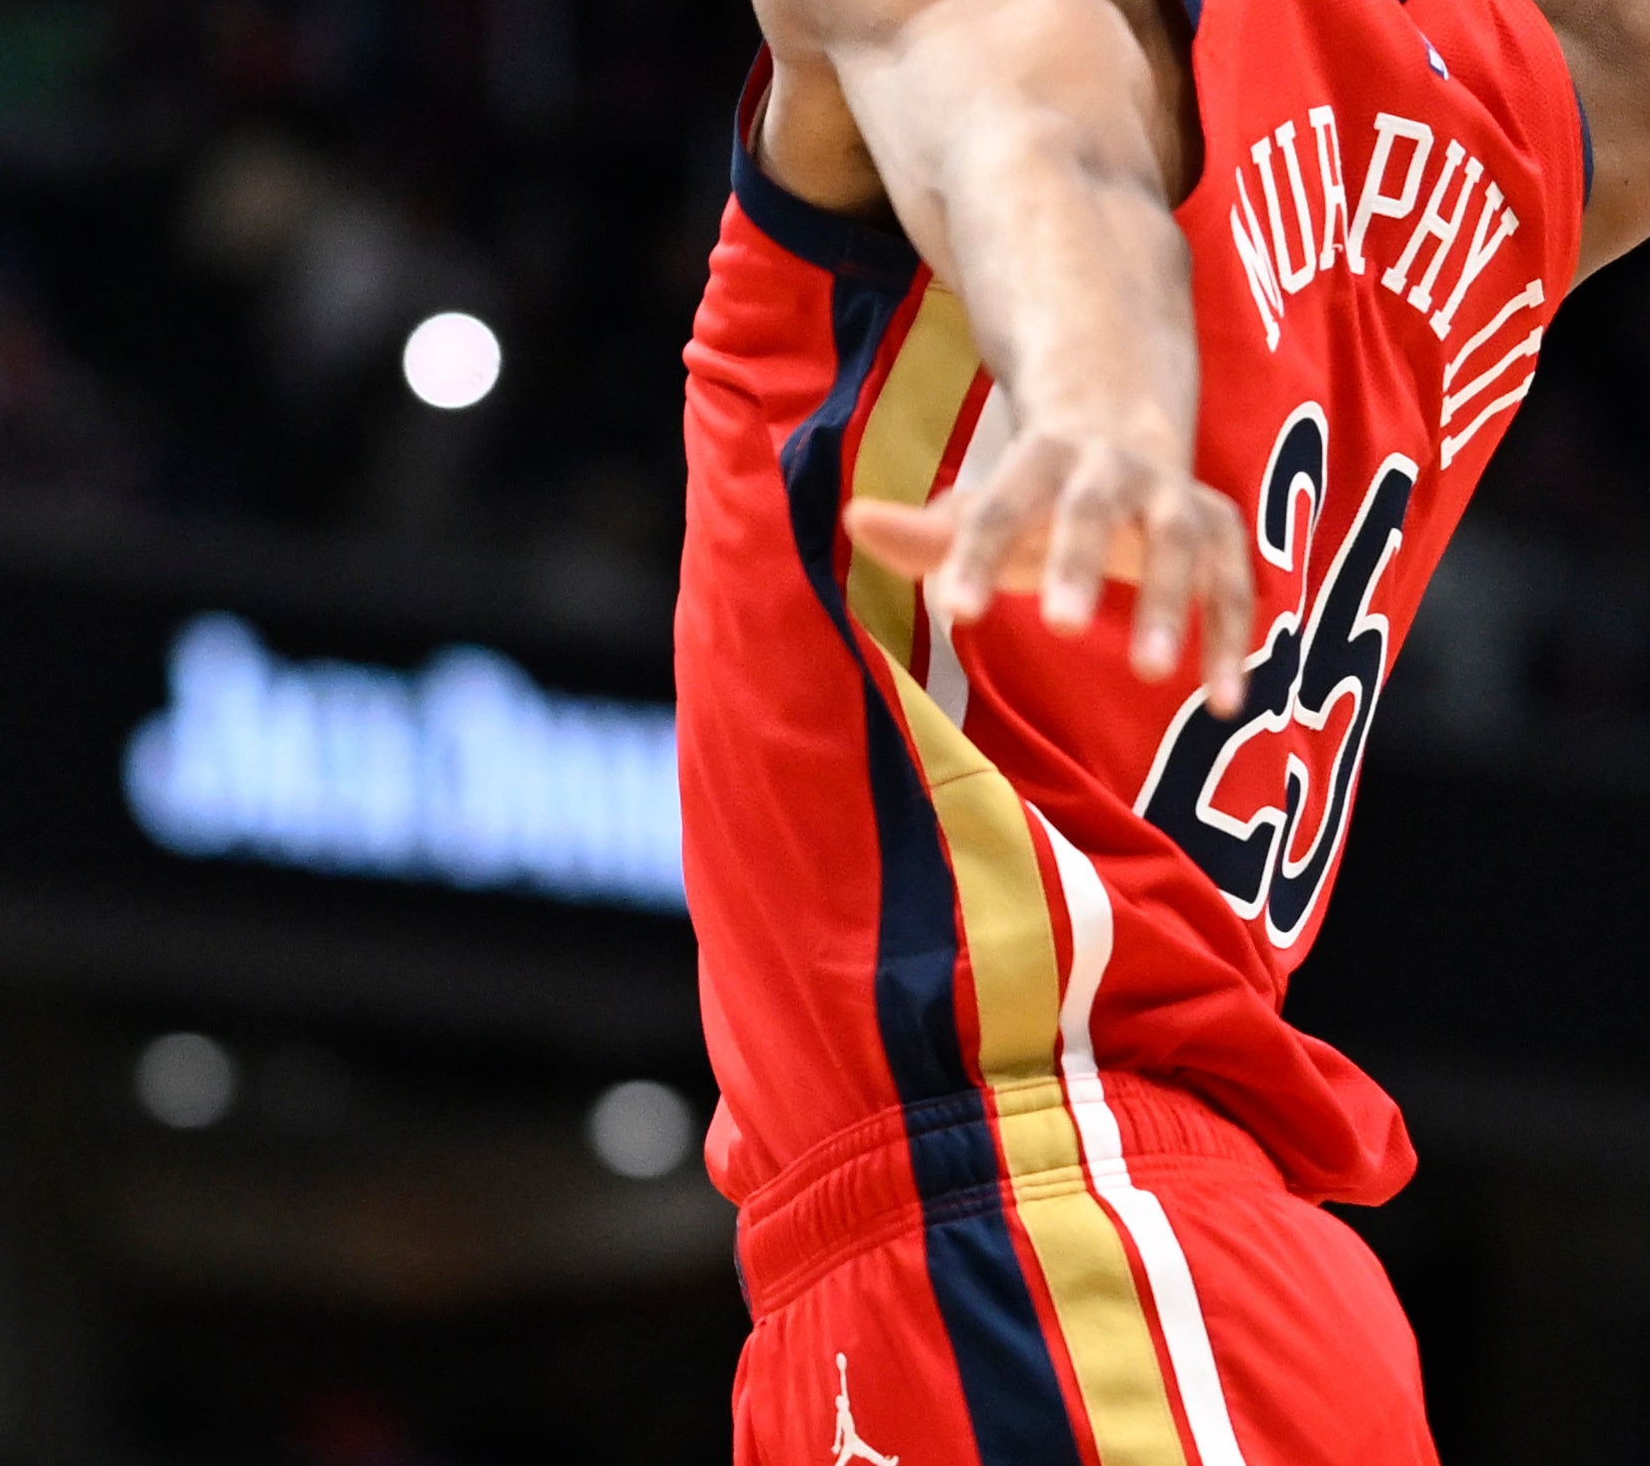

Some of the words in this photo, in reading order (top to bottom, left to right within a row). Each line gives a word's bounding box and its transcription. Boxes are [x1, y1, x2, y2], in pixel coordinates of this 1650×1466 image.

[1230, 104, 1519, 353] MURPHY
[1439, 278, 1545, 470] III
[1132, 400, 1419, 950] 25
